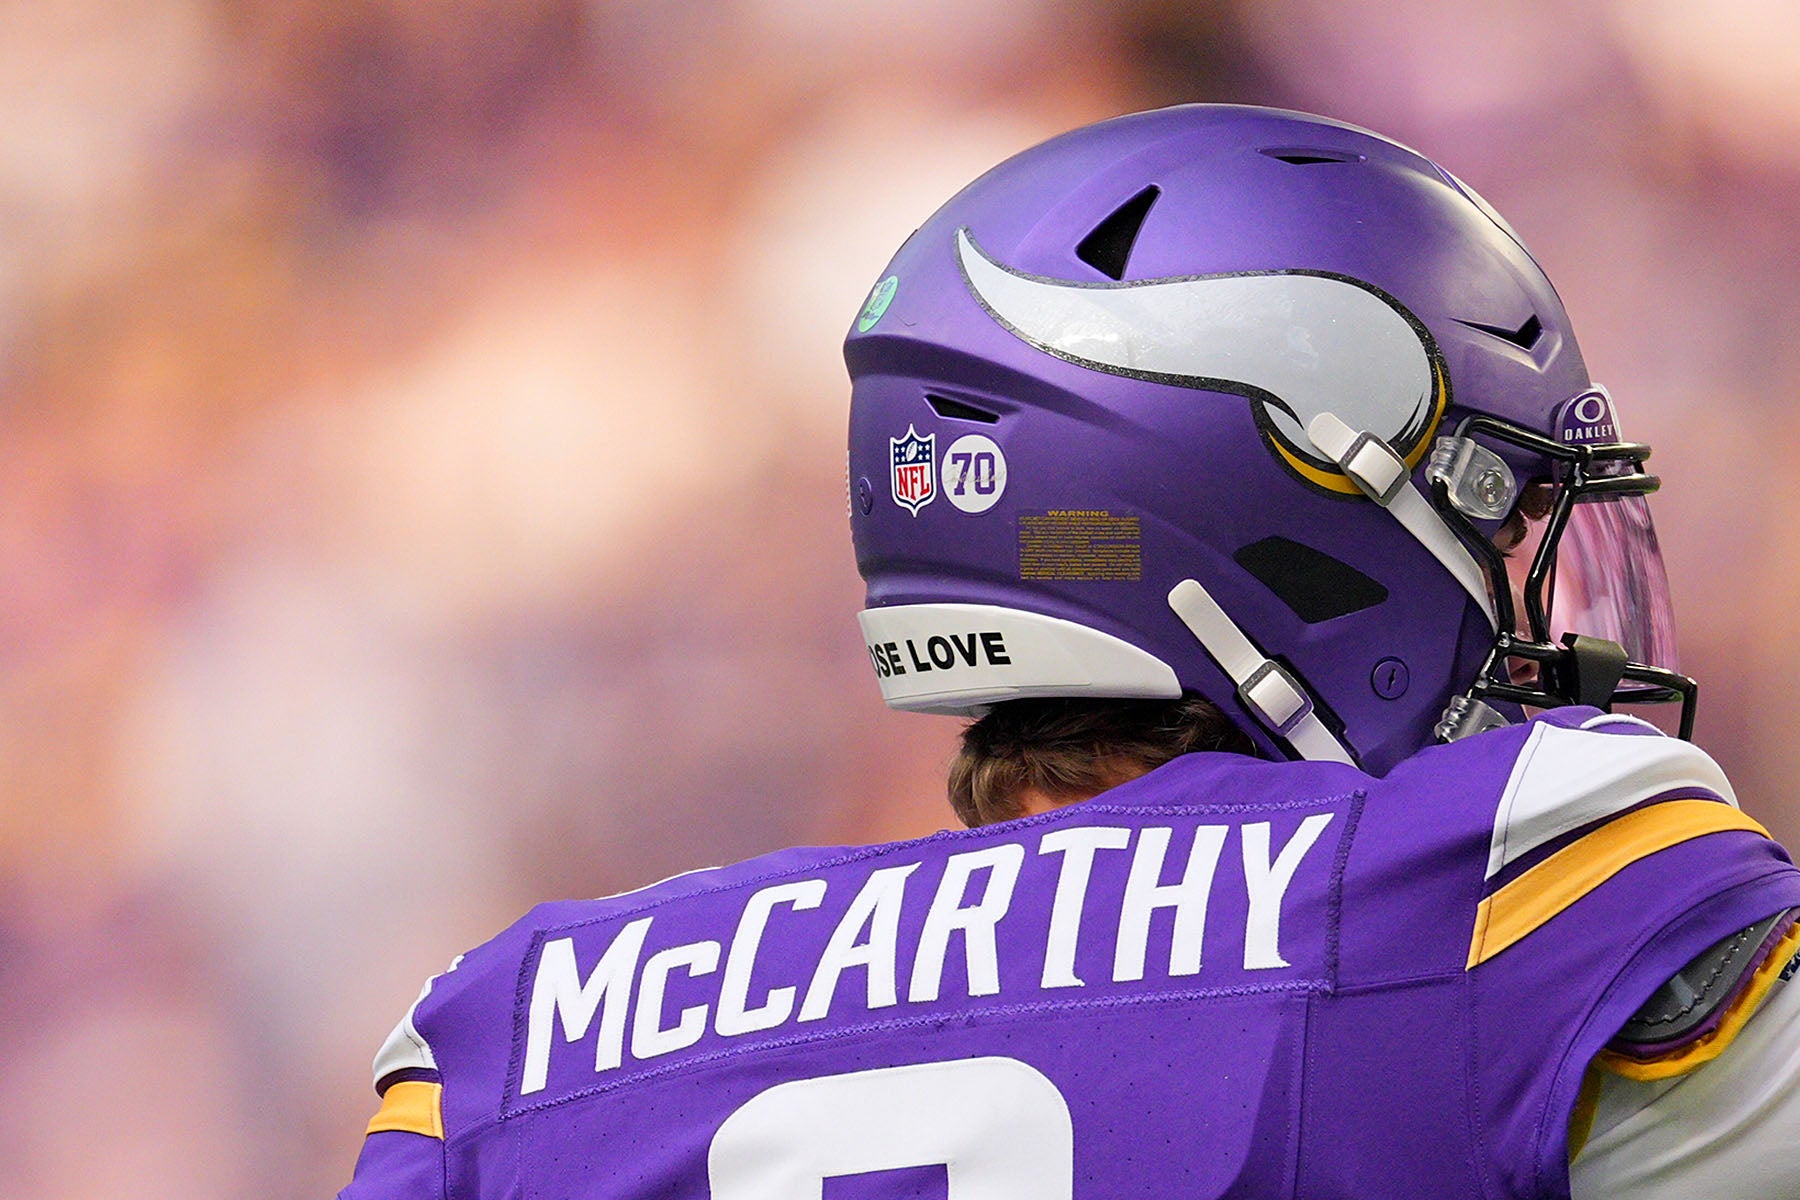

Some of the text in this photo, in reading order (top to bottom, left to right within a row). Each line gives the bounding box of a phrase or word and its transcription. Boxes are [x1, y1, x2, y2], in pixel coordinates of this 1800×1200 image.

[1564, 424, 1614, 441] OAKLEY
[897, 465, 931, 501] NFL
[951, 452, 996, 496] 70
[905, 632, 1012, 672] LOVE
[520, 813, 1334, 1096] McCARTHY
